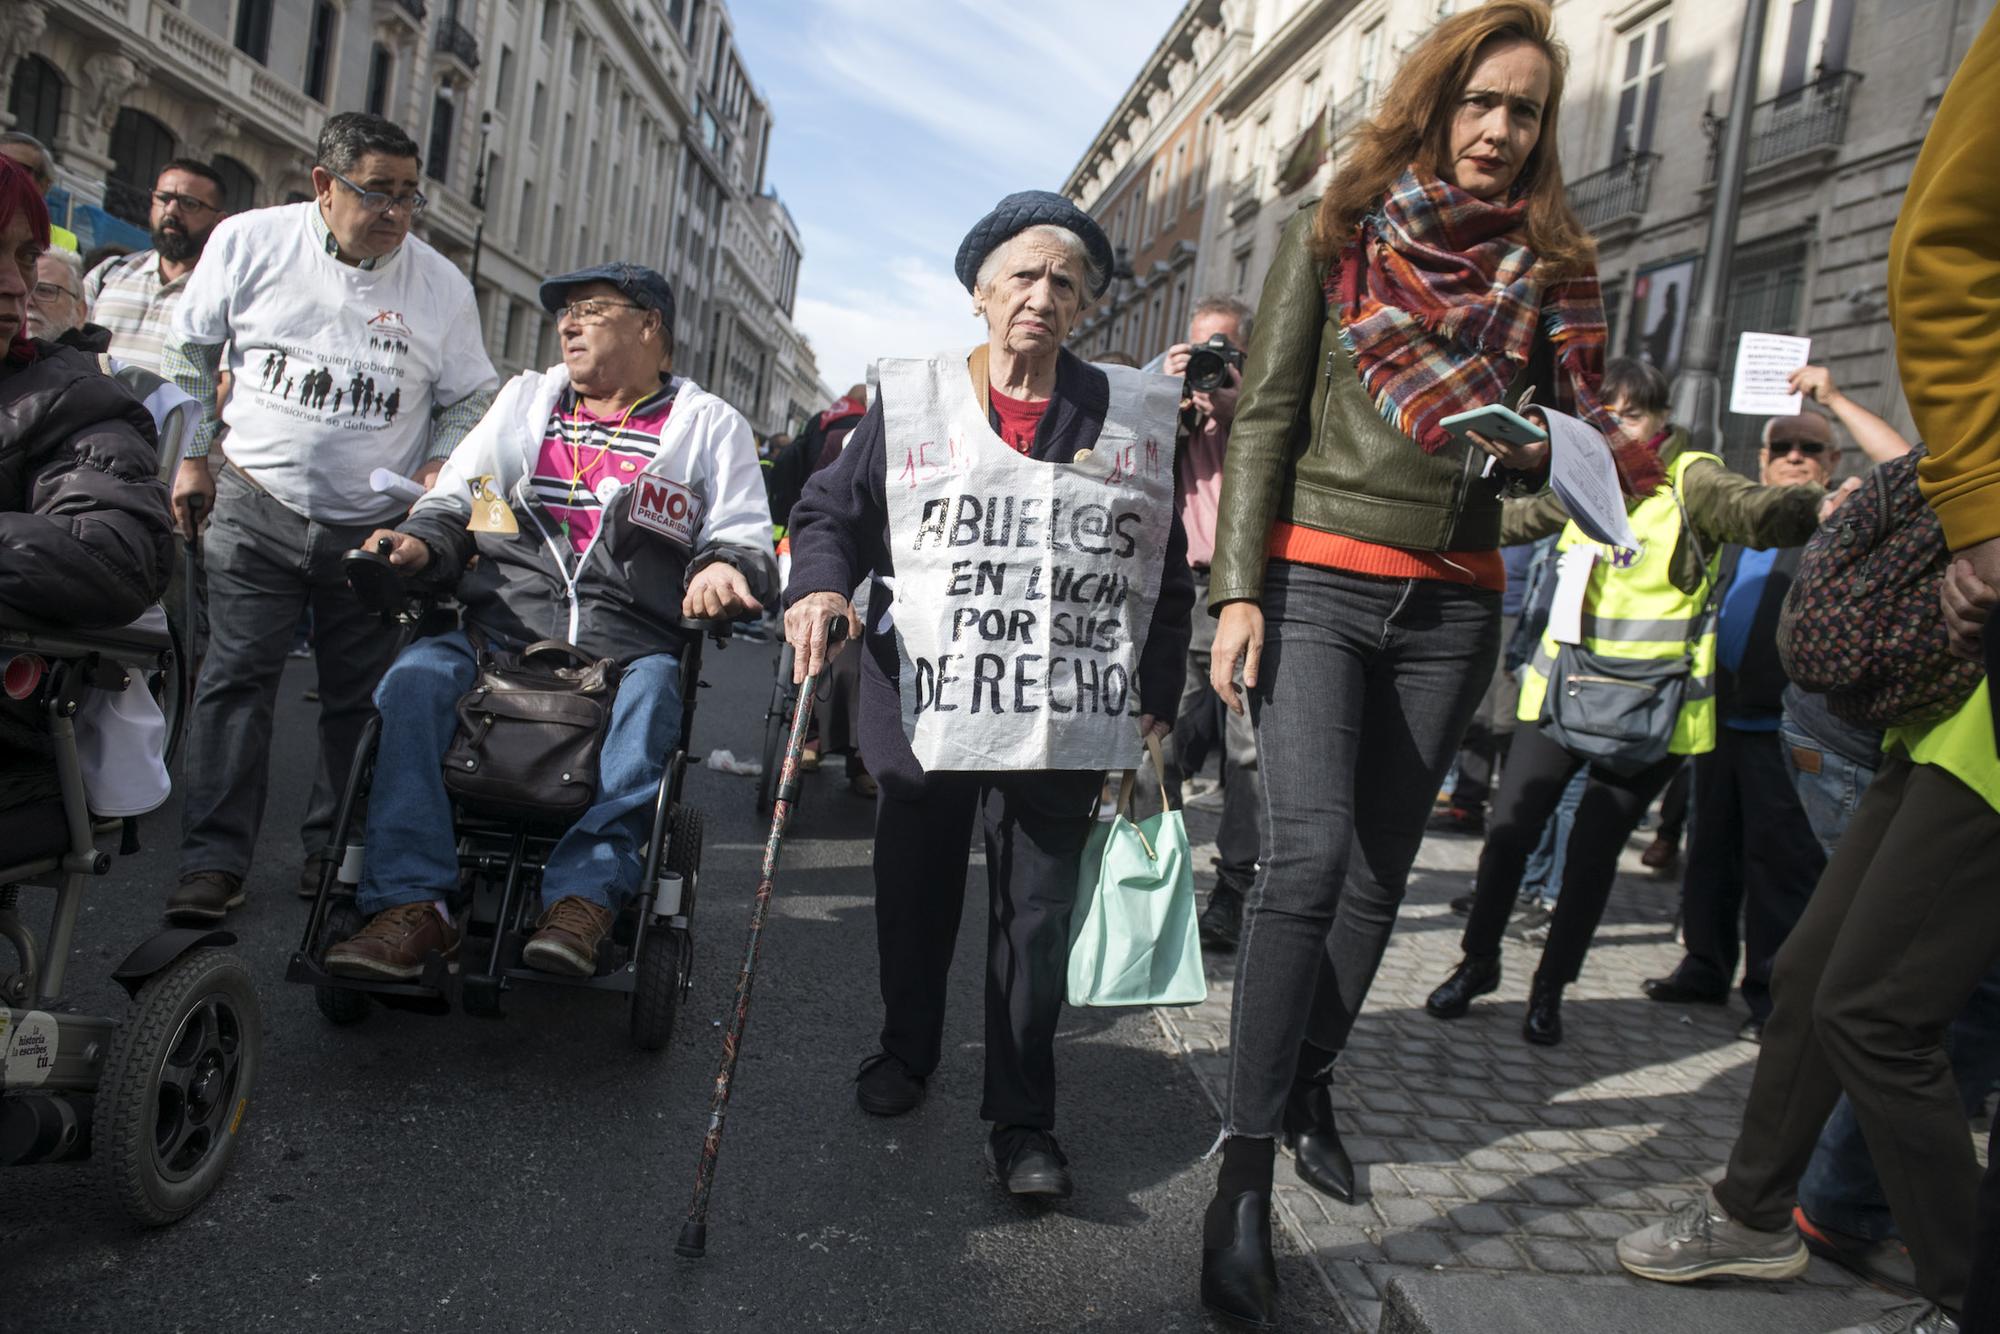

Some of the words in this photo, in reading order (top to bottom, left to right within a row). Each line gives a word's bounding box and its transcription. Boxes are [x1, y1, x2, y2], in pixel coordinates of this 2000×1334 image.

[317, 353, 351, 366] quien
[266, 401, 321, 422] pensiones
[325, 417, 340, 427] se
[637, 507, 690, 535] PRECARIEDA
[913, 494, 1141, 558] ABUEL@S
[946, 560, 1007, 596] EN
[952, 607, 1037, 644] POR
[1050, 612, 1121, 652] SUS
[19, 1035, 45, 1046] historia
